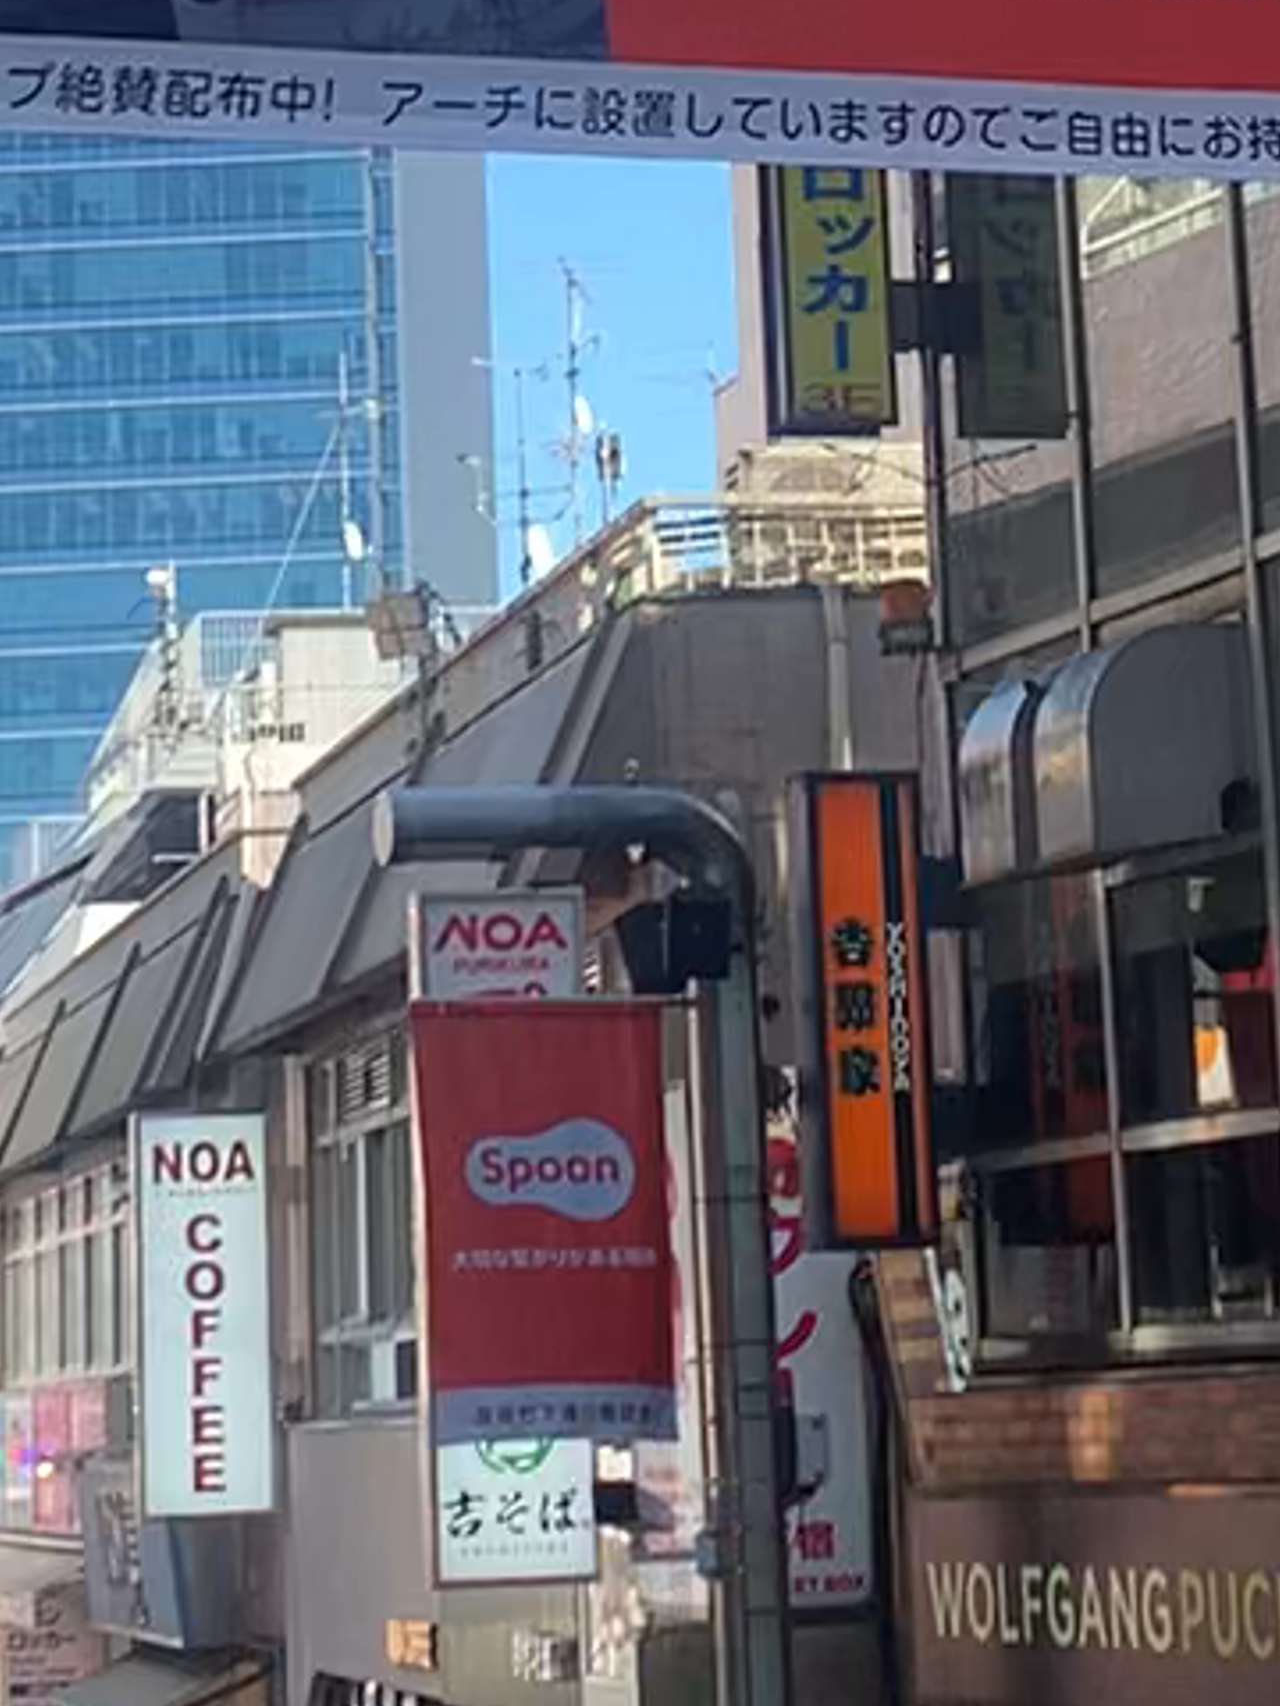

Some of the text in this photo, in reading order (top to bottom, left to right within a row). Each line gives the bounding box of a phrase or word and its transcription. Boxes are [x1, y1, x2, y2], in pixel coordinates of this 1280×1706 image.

[433, 912, 568, 953] NOA
[152, 1140, 255, 1185] NOA
[480, 1148, 620, 1194] Spoon
[184, 1214, 226, 1493] COFFEE
[443, 1487, 576, 1538] 吉そば
[927, 1561, 1173, 1653] WOLFGANG
